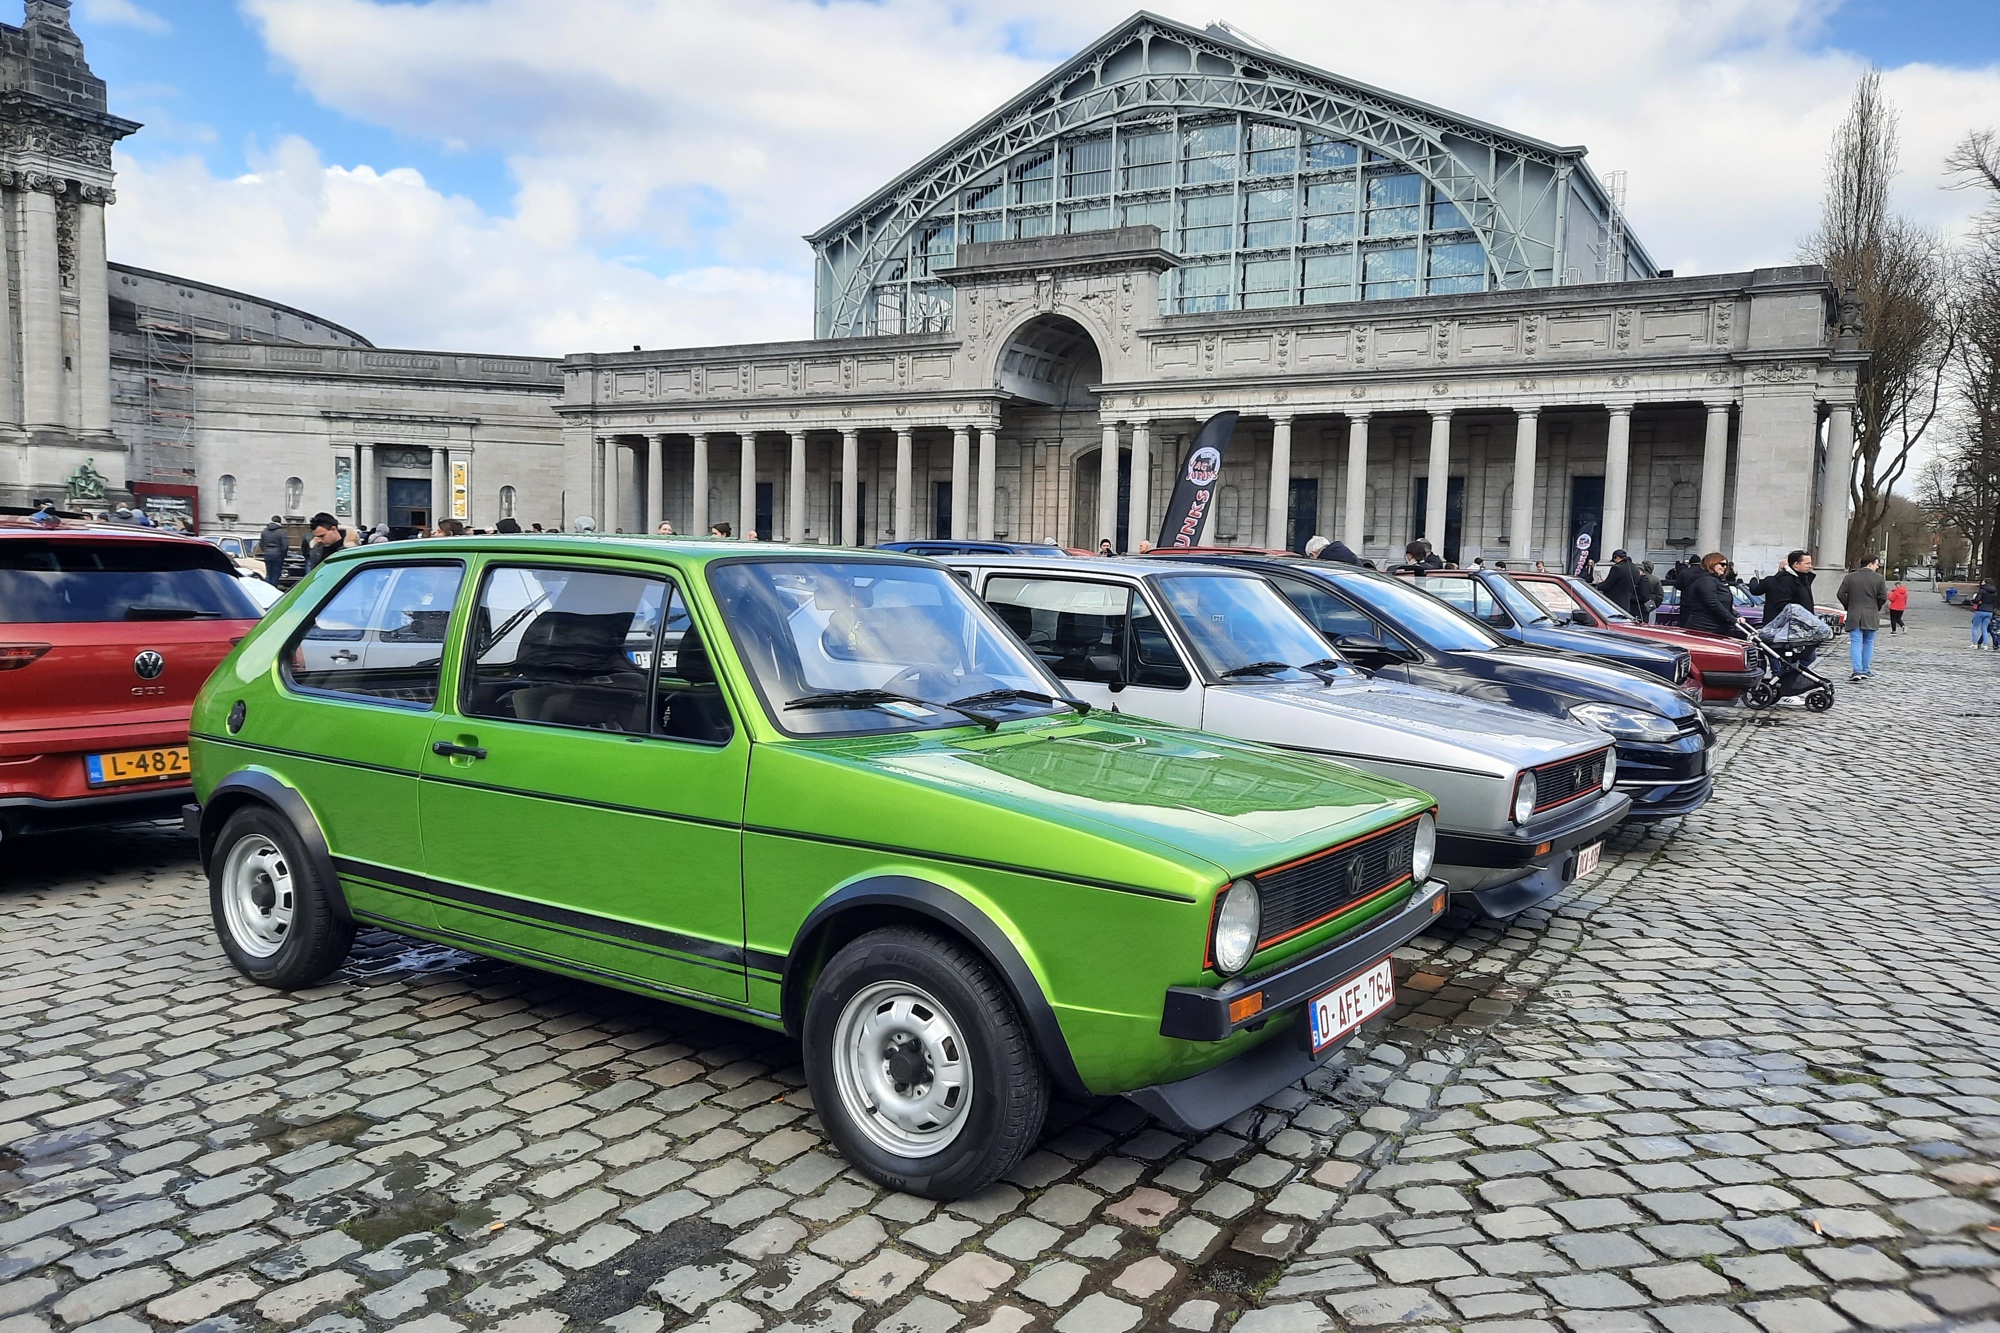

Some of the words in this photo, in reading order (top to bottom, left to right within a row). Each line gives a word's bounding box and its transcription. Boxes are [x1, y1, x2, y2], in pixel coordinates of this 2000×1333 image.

[1174, 489, 1210, 547] UNKS
[1212, 614, 1225, 622] GTI
[131, 686, 165, 696] GTI
[111, 751, 188, 776] L-482-
[1388, 847, 1404, 870] GTI
[1312, 1030, 1319, 1047] B
